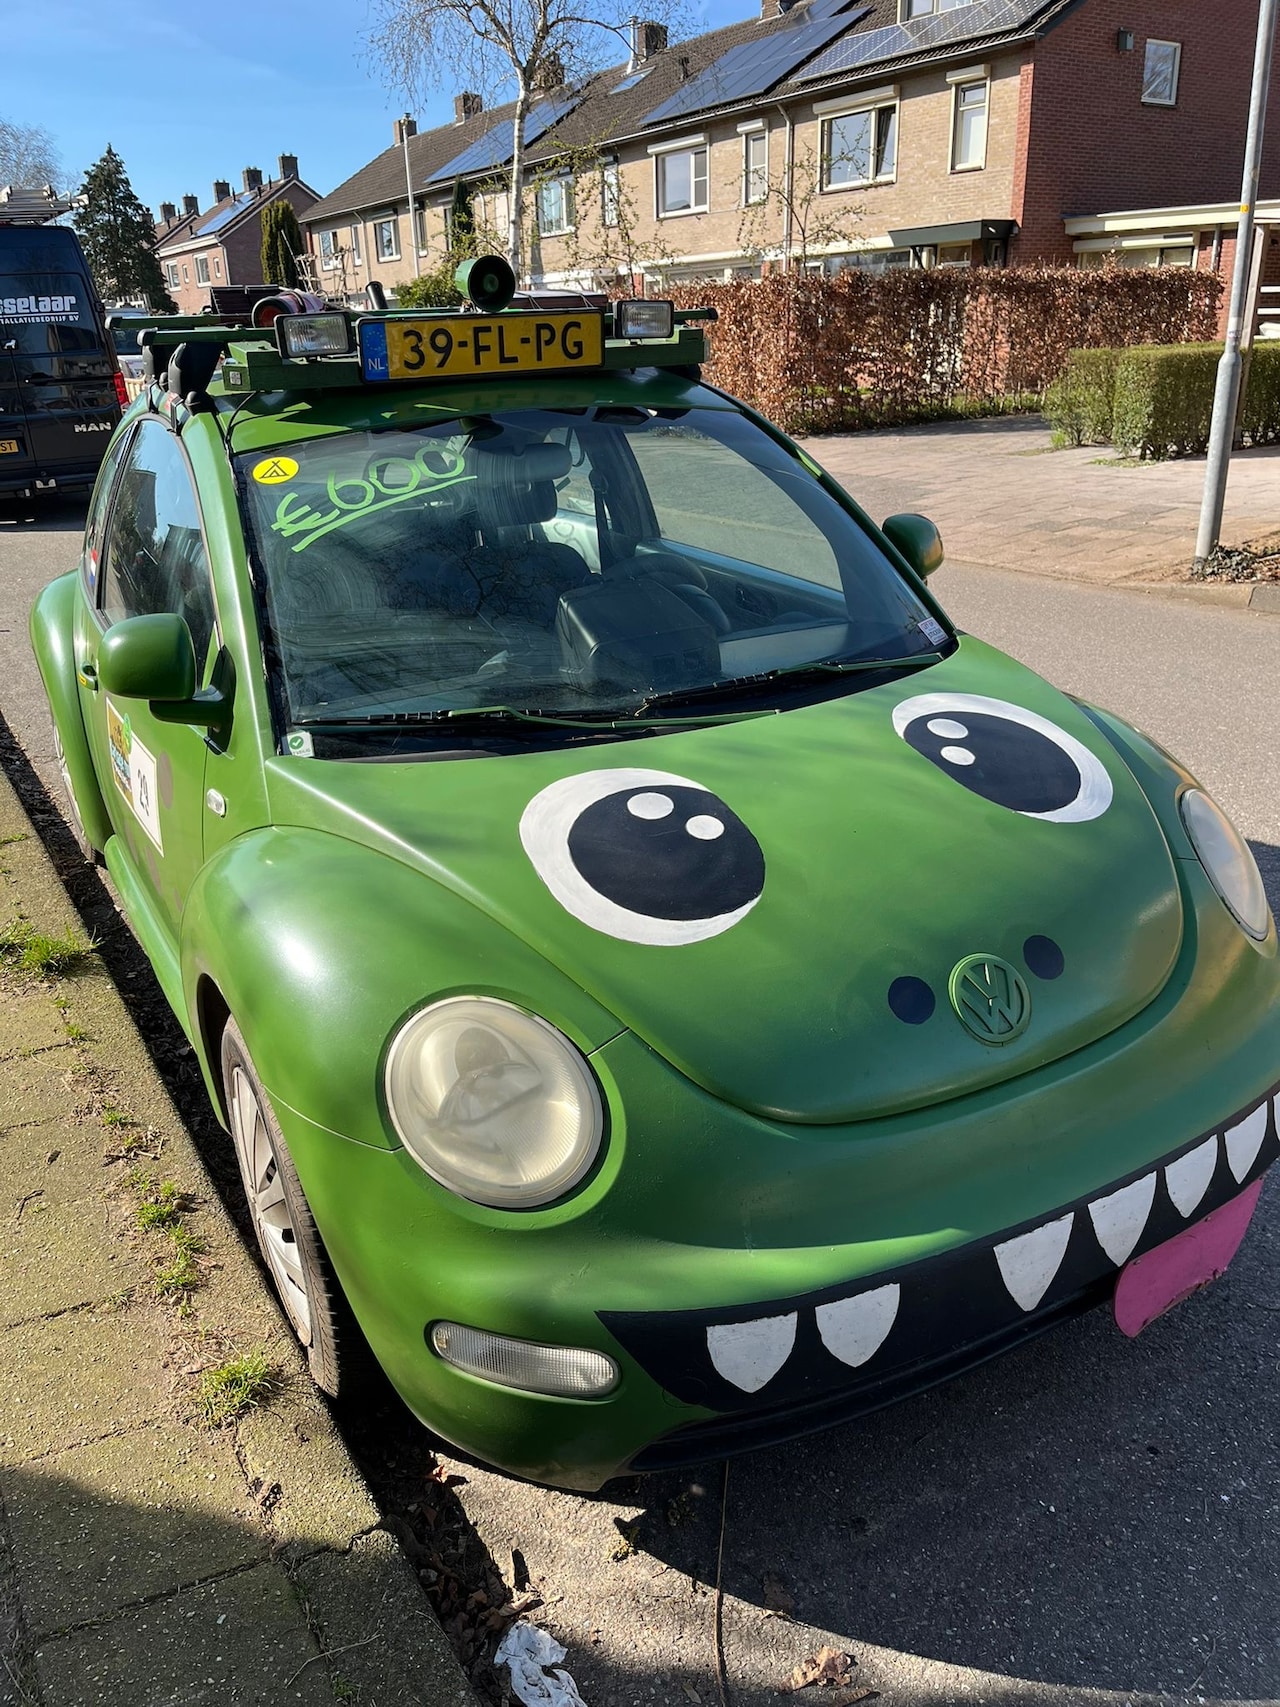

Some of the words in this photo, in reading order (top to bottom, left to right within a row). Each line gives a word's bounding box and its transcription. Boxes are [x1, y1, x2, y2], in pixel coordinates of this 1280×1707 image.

[402, 321, 584, 370] 39-FL-PG
[367, 358, 386, 370] NL
[74, 422, 112, 433] MAN
[0, 441, 13, 452] ST
[271, 446, 466, 537] €600
